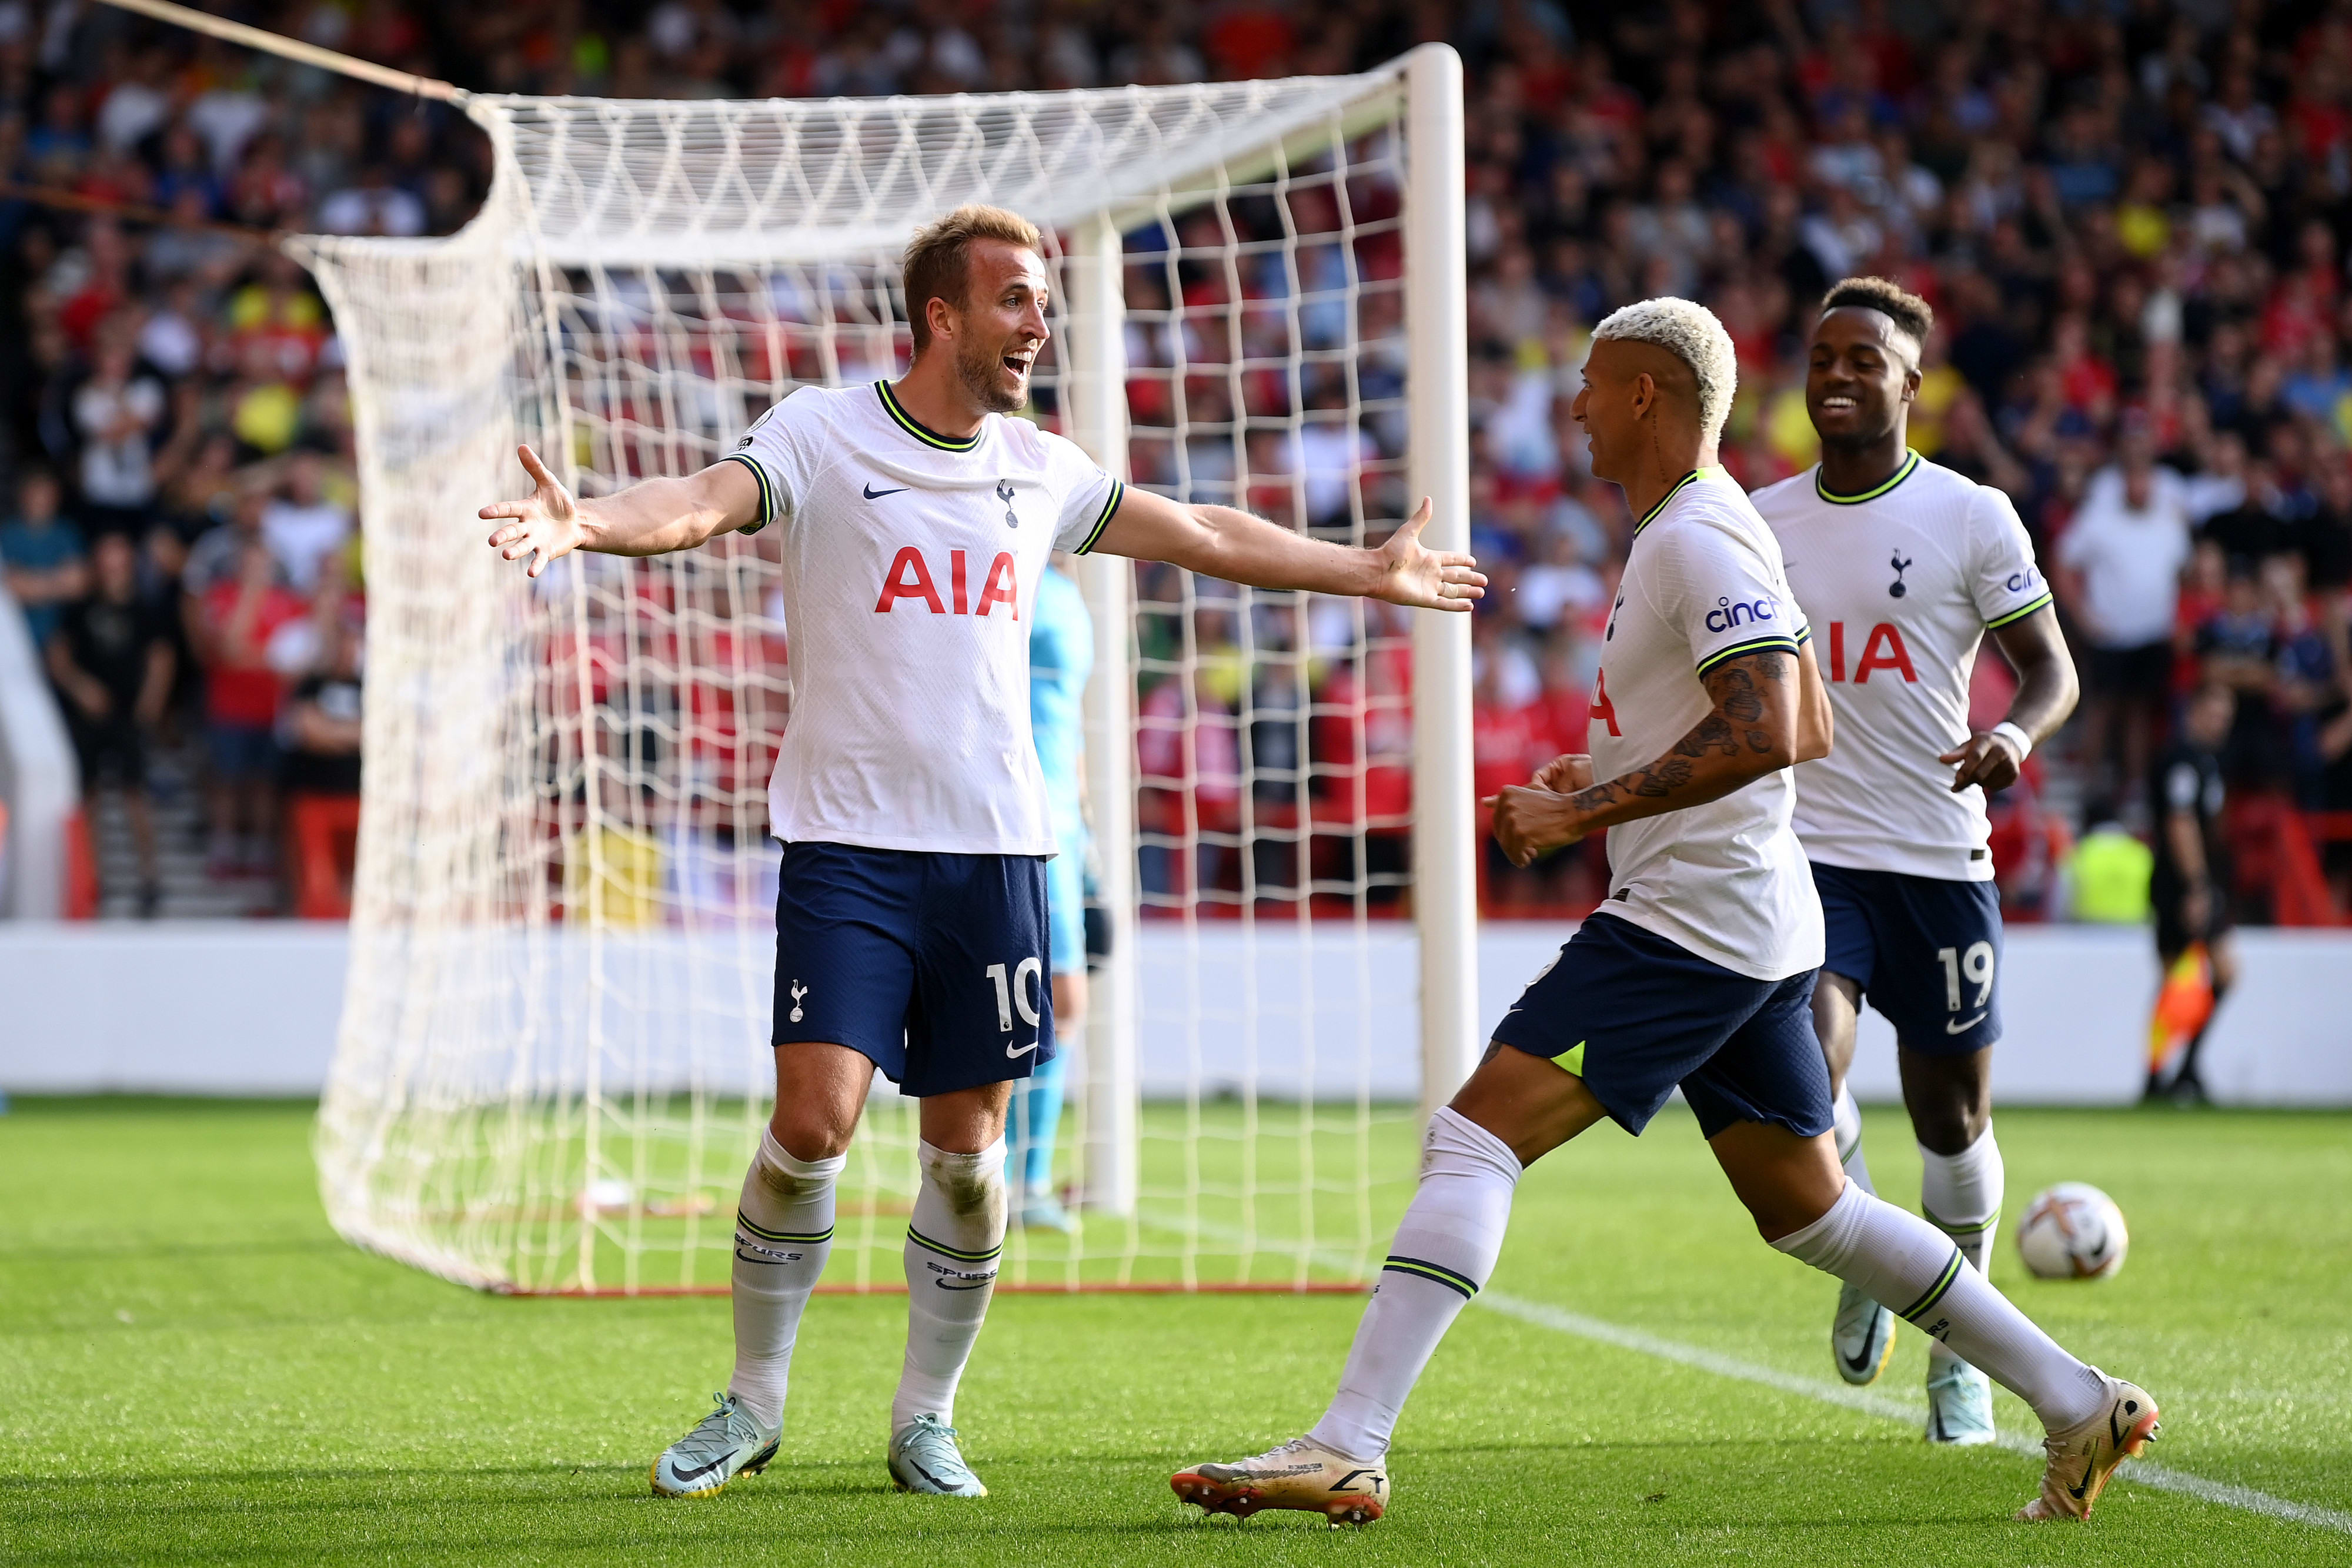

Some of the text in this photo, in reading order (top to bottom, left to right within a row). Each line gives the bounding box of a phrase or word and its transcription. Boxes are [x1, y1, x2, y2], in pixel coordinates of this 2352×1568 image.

[875, 546, 1018, 621] AIA
[1706, 596, 1787, 633] cinch
[986, 957, 1041, 1032] 10
[1938, 940, 1994, 1012] 19
[734, 1233, 803, 1261] SPURS
[927, 1262, 997, 1280] SPURS
